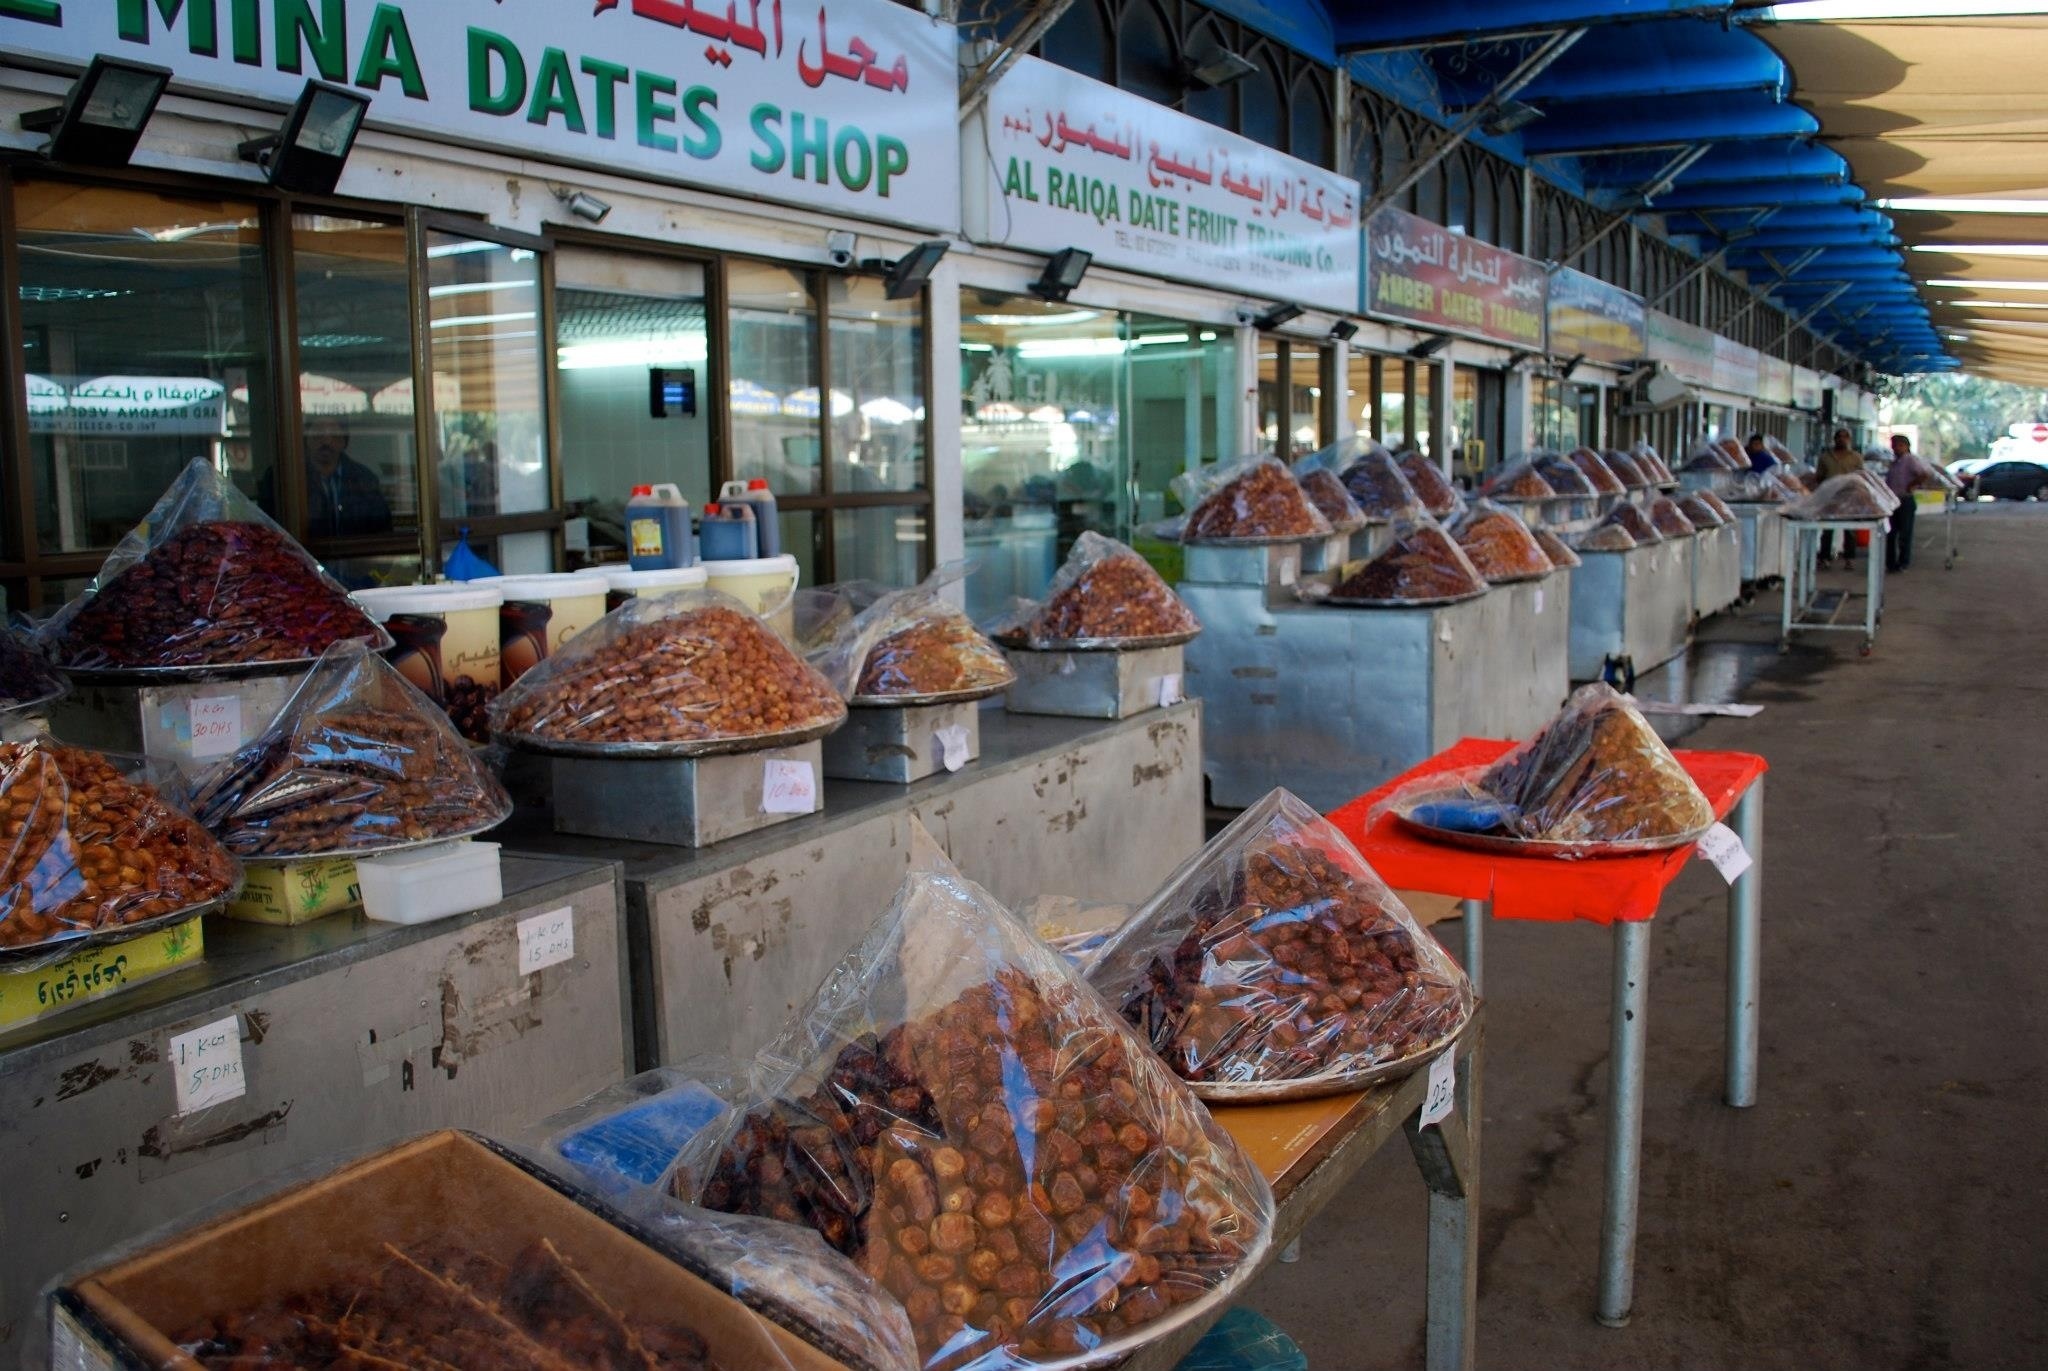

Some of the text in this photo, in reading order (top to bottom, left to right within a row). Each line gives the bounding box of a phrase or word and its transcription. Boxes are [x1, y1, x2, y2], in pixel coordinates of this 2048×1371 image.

[797, 6, 909, 94] محل
[466, 25, 722, 160] DATES
[749, 102, 908, 199] SHOP
[1004, 156, 1039, 202] AL
[1048, 166, 1120, 226] RAIQA
[1129, 189, 1180, 236] DATE
[1187, 206, 1238, 248] FRUIT
[1377, 271, 1434, 312] AMBER
[1441, 287, 1484, 326] DATES
